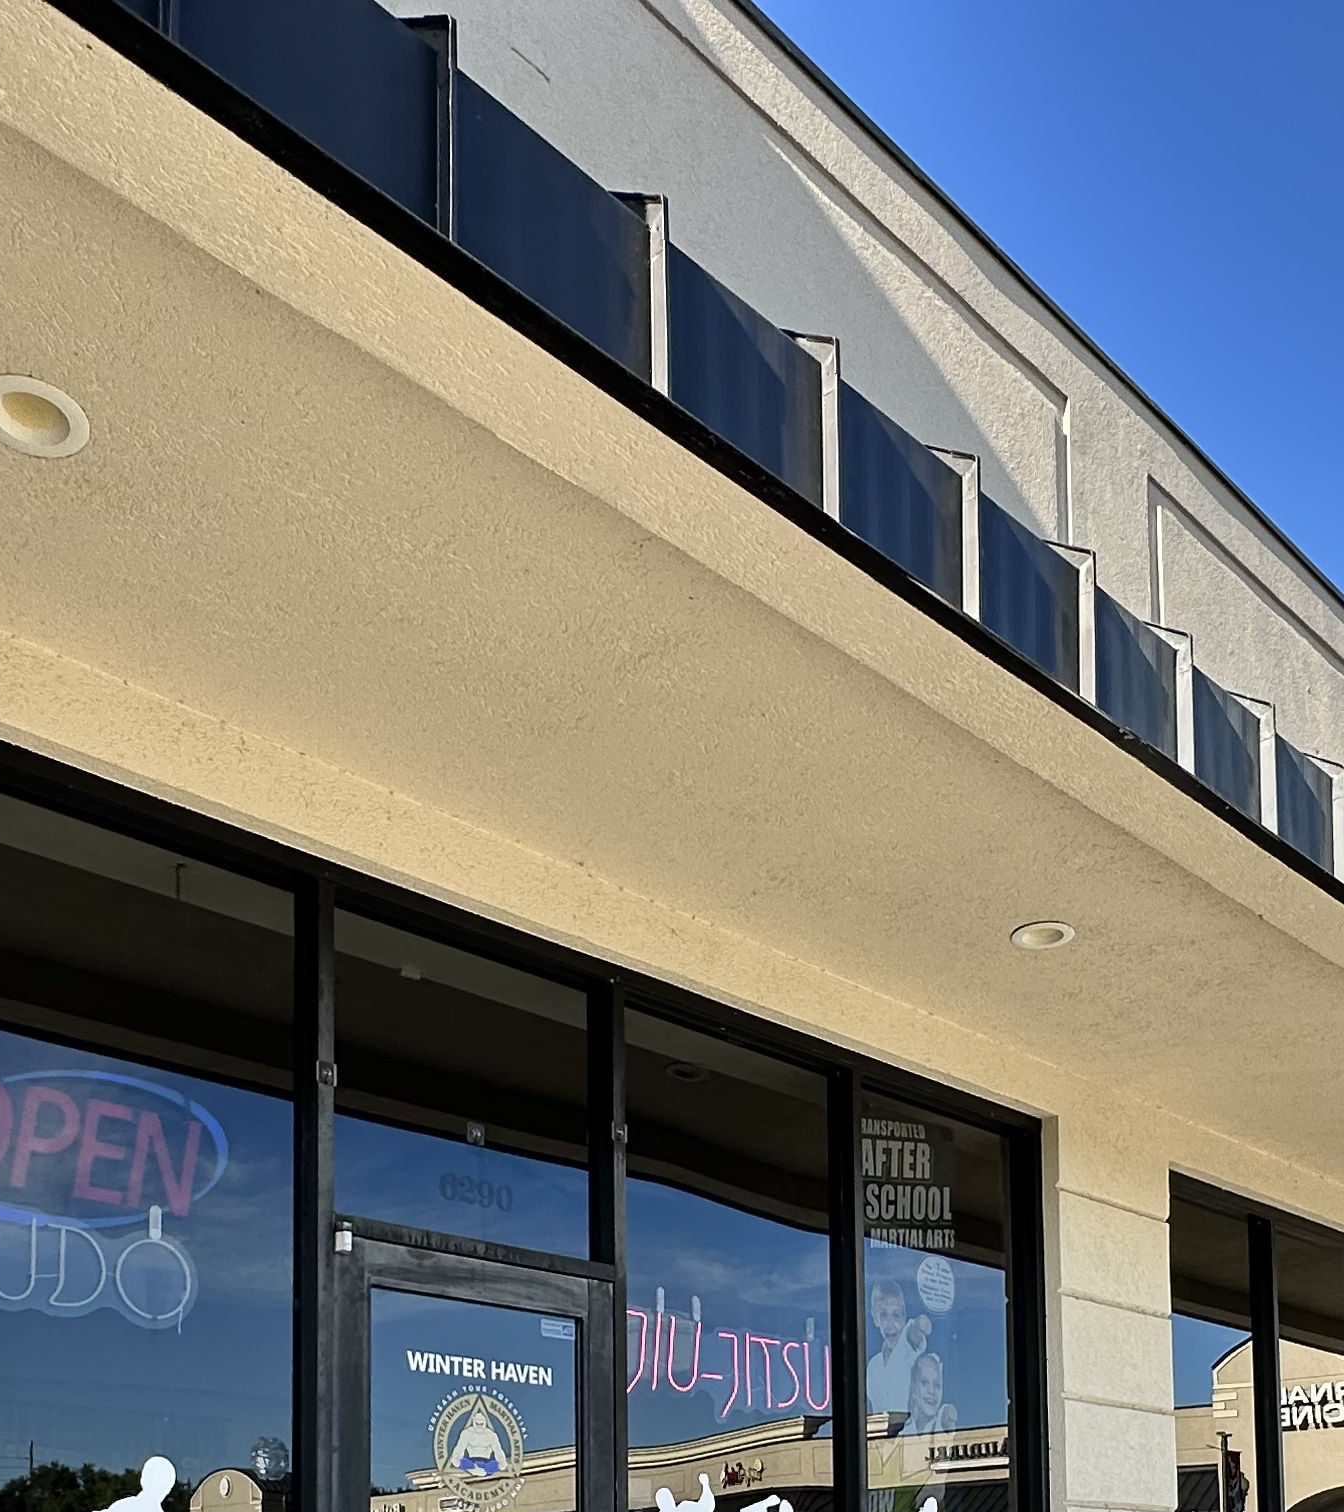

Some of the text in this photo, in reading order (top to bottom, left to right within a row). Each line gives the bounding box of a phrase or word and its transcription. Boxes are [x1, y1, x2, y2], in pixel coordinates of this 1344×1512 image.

[861, 1138, 931, 1179] AFTER
[439, 1171, 513, 1213] 6290
[865, 1183, 952, 1222] SCHOOL
[870, 1227, 955, 1249] MARTIAL ARTS
[406, 1350, 553, 1387] WINTER HAVEN
[626, 1308, 831, 1418] JIU-JITSU
[427, 1384, 529, 1440] UNLEASH YOUR POTENTIAL
[436, 1397, 471, 1460] WINTER HAVEN
[488, 1400, 517, 1438] MARTIAL
[452, 1481, 506, 1501] ACADEMY
